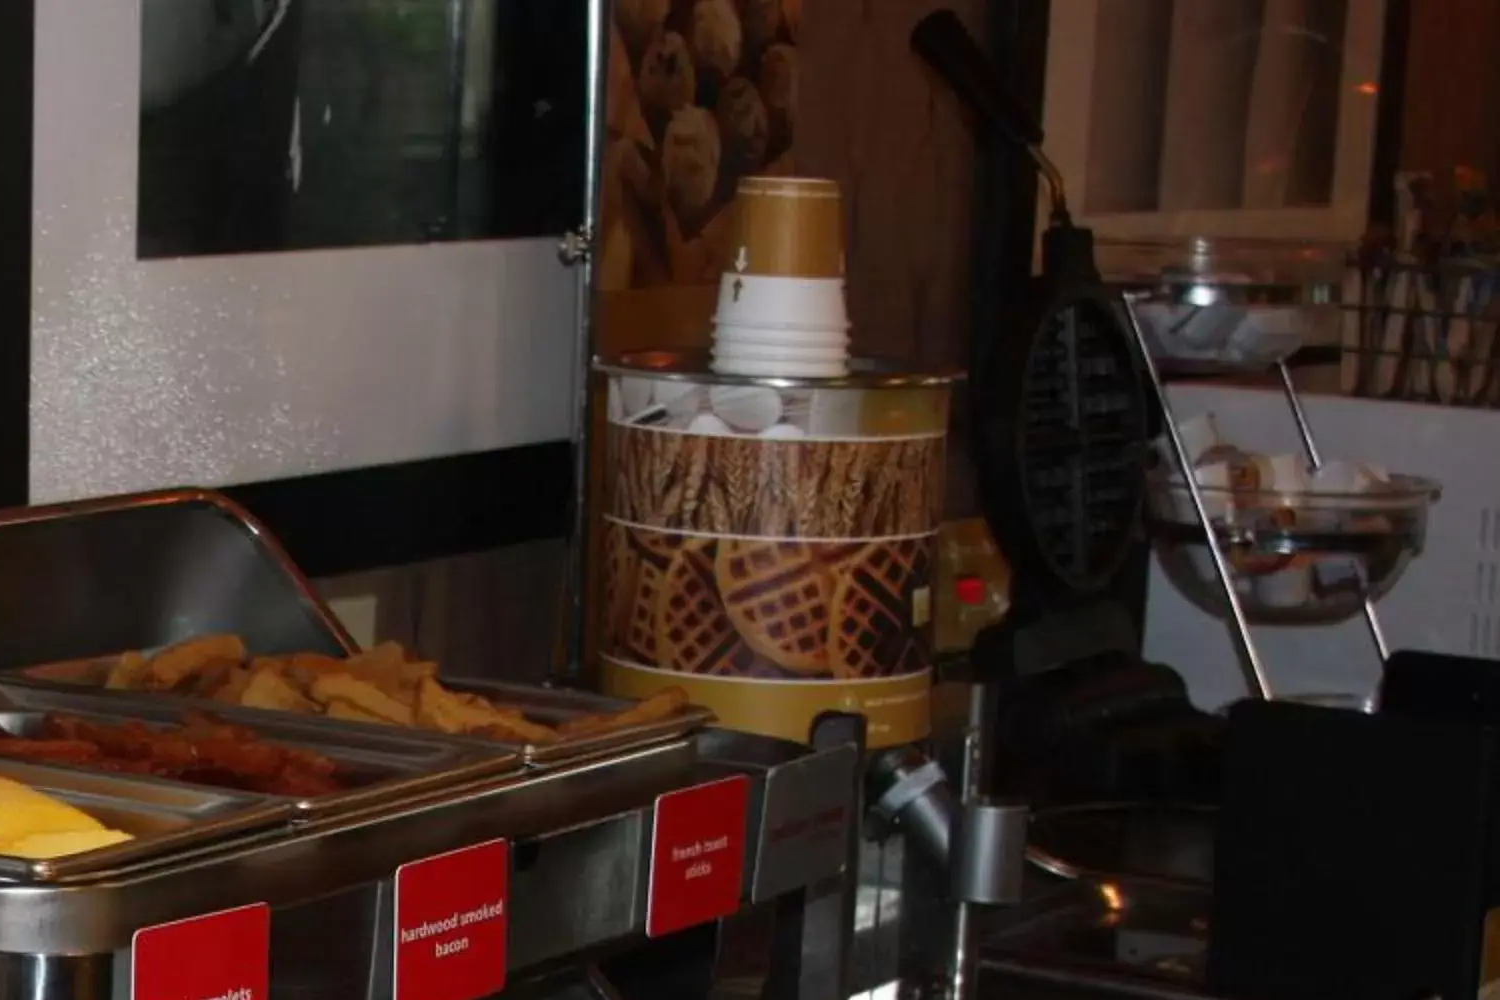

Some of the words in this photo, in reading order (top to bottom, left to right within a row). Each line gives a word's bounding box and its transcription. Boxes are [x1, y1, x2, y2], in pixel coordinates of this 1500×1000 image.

[672, 841, 702, 862] french
[401, 912, 459, 944] hardwood
[460, 898, 503, 927] smoked
[435, 937, 469, 958] bacon
